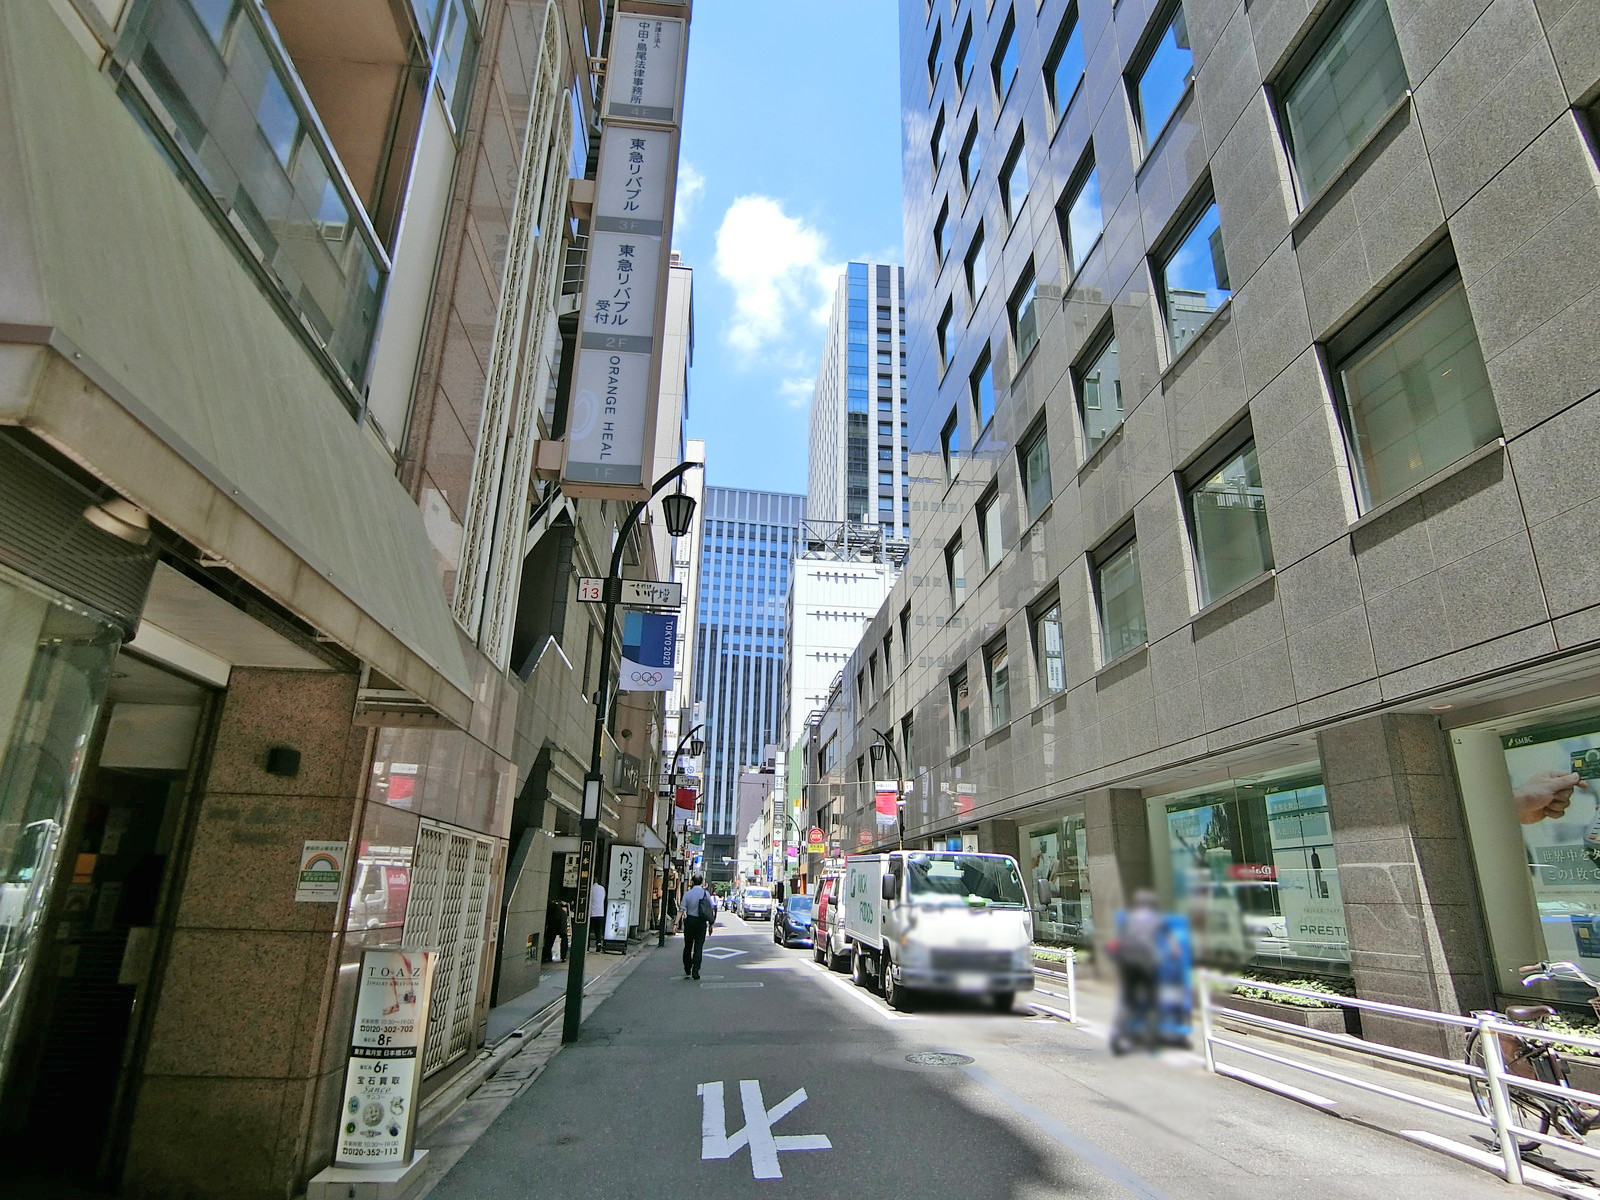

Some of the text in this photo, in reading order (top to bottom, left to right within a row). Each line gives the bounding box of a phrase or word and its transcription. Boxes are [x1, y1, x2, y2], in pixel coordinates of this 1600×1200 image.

[630, 107, 650, 117] 4F
[623, 138, 646, 211] 東急リバブル
[618, 220, 640, 230] 3F
[611, 244, 635, 326] 東急リバブル
[594, 299, 610, 324] 受付
[606, 337, 629, 348] 2F
[600, 355, 621, 460] ORANGE HEAL
[593, 467, 616, 478] 1F
[582, 587, 599, 599] 13
[662, 620, 673, 665] TOKYO 2020
[1514, 735, 1534, 745] SMBC
[1299, 924, 1347, 936] PRESTI
[369, 967, 420, 977] TOAZ
[377, 1033, 392, 1046] 8F
[373, 1060, 389, 1074] 6F
[357, 1076, 400, 1085] 宝石買取
